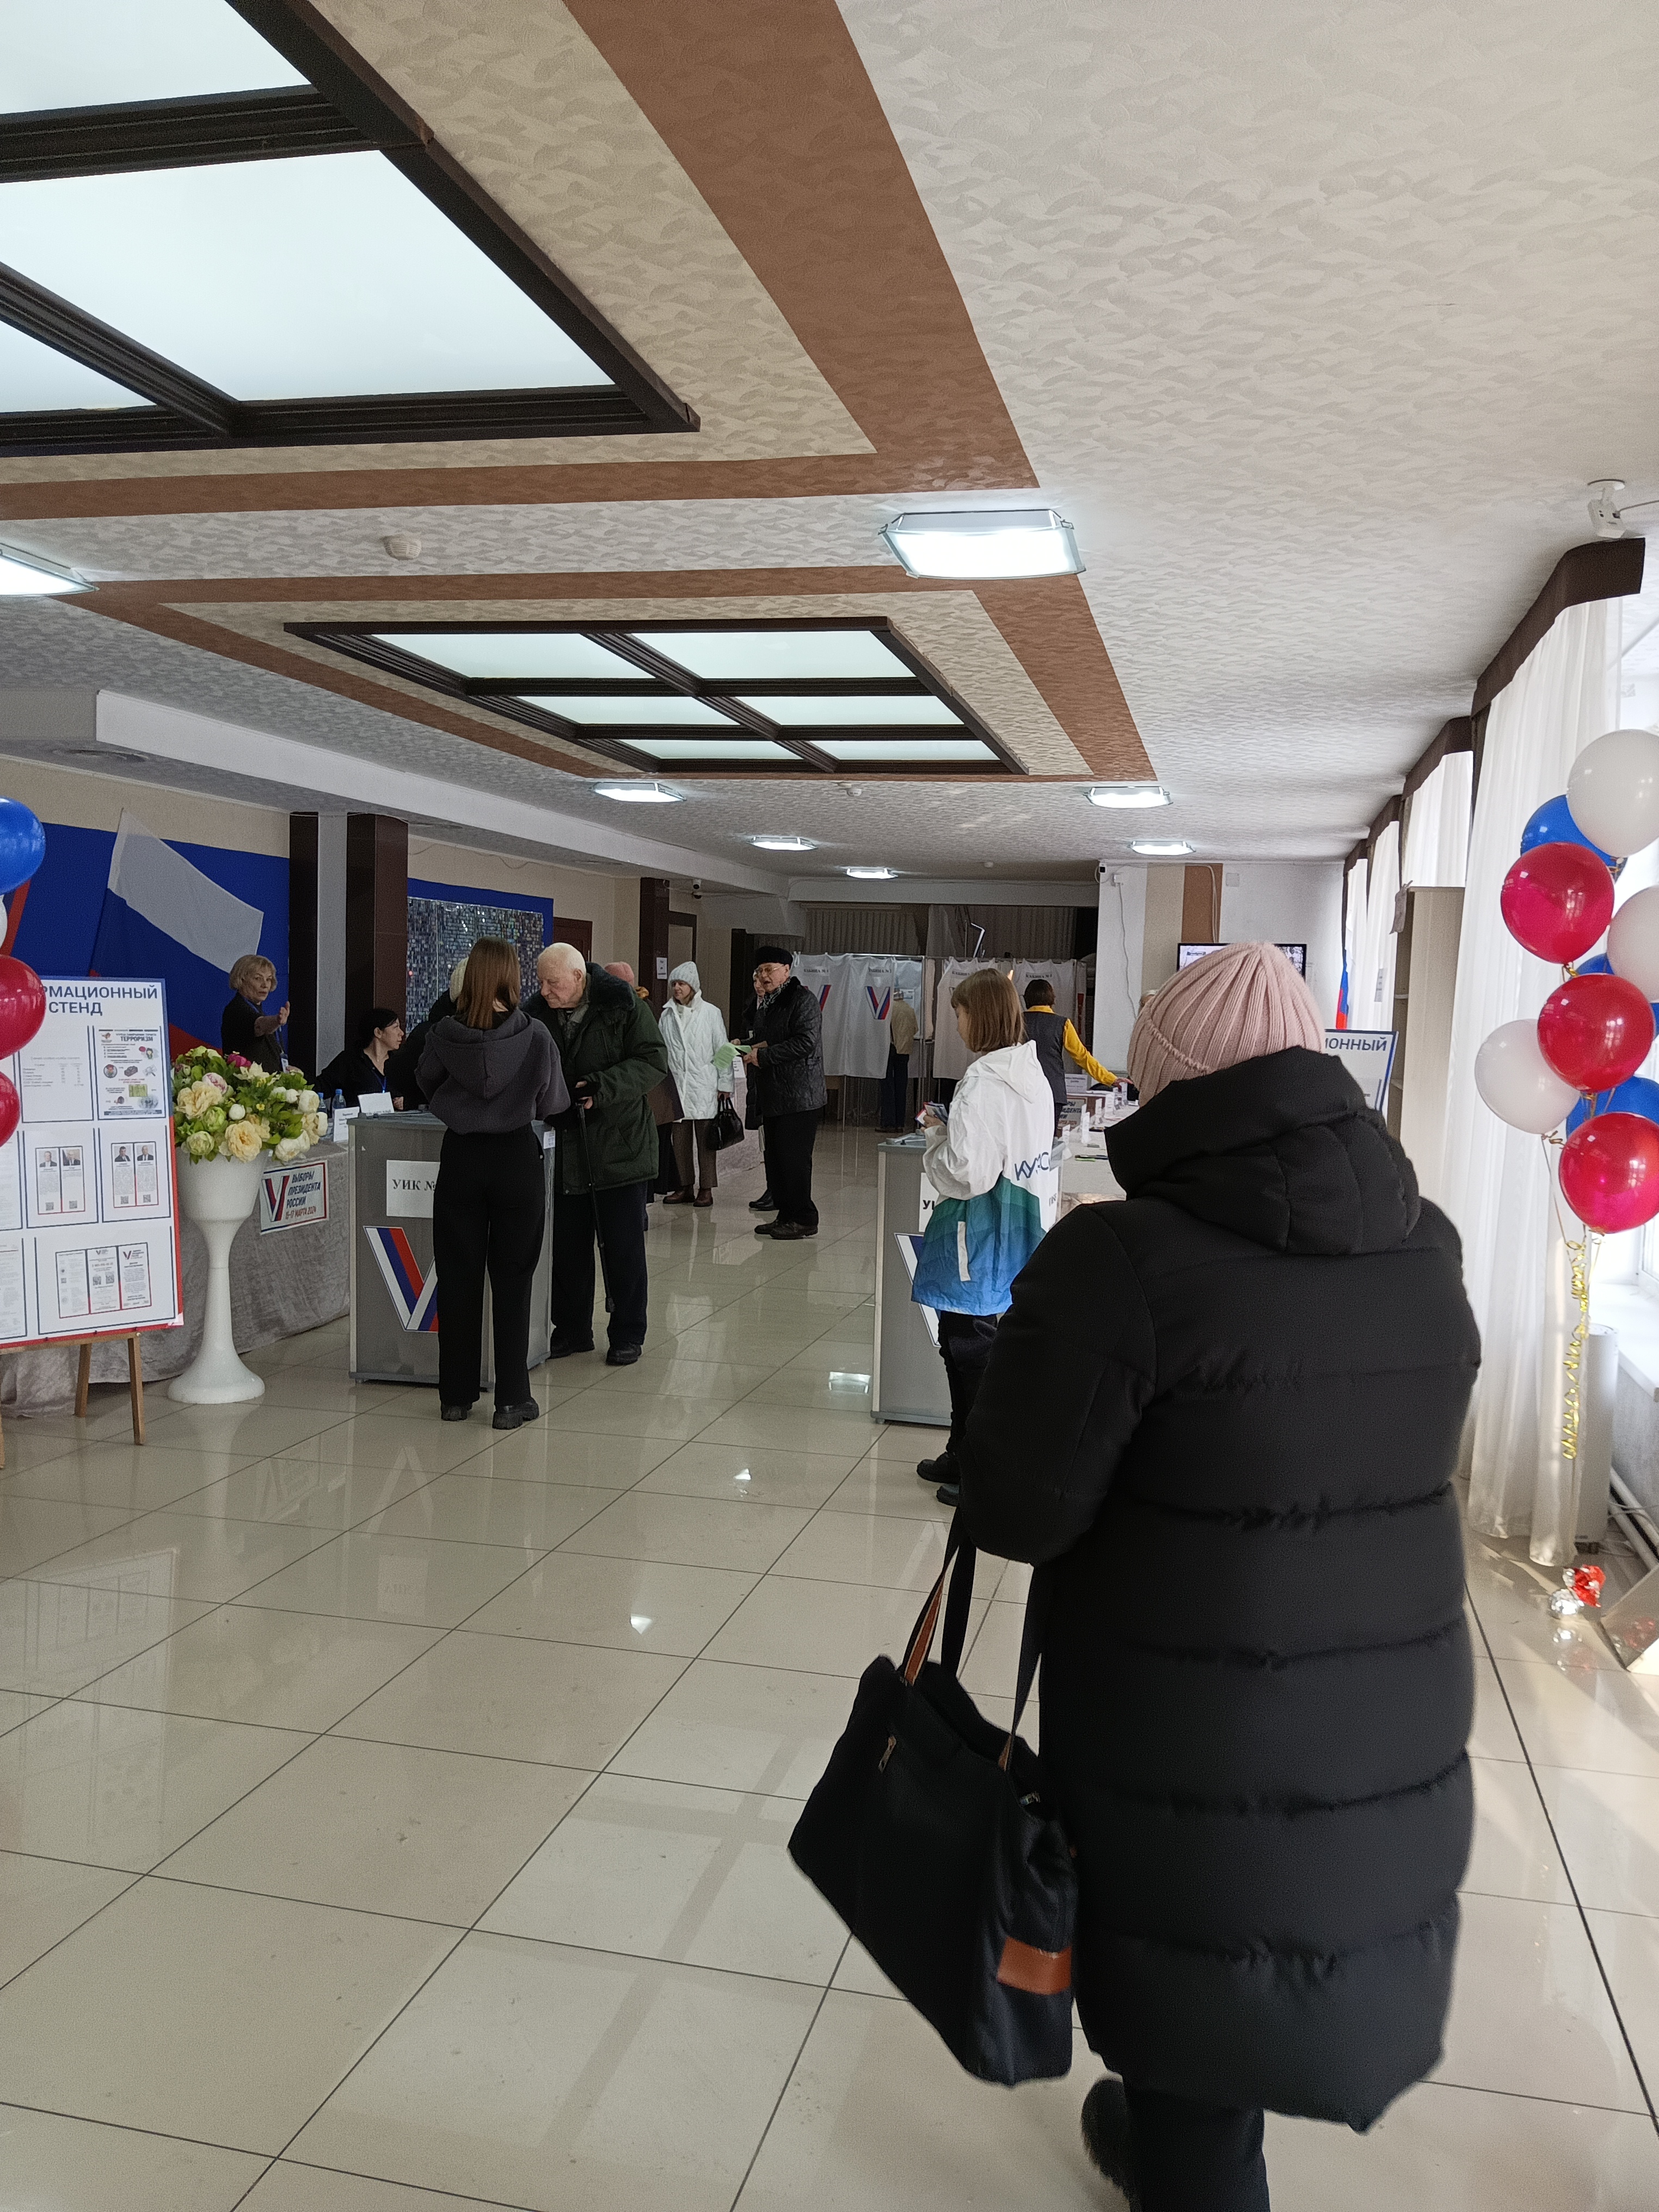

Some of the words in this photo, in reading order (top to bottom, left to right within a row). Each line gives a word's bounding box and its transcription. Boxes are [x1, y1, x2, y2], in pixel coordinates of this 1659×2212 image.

[48, 1001, 102, 1016] СТЕНД
[292, 1171, 315, 1183] ВЫБОРЫ
[288, 1182, 321, 1195] ПРЕЗИДЕНТА
[391, 1178, 421, 1191] УИК
[286, 1196, 306, 1208] РОССИИ
[295, 1207, 307, 1217] МАРТА
